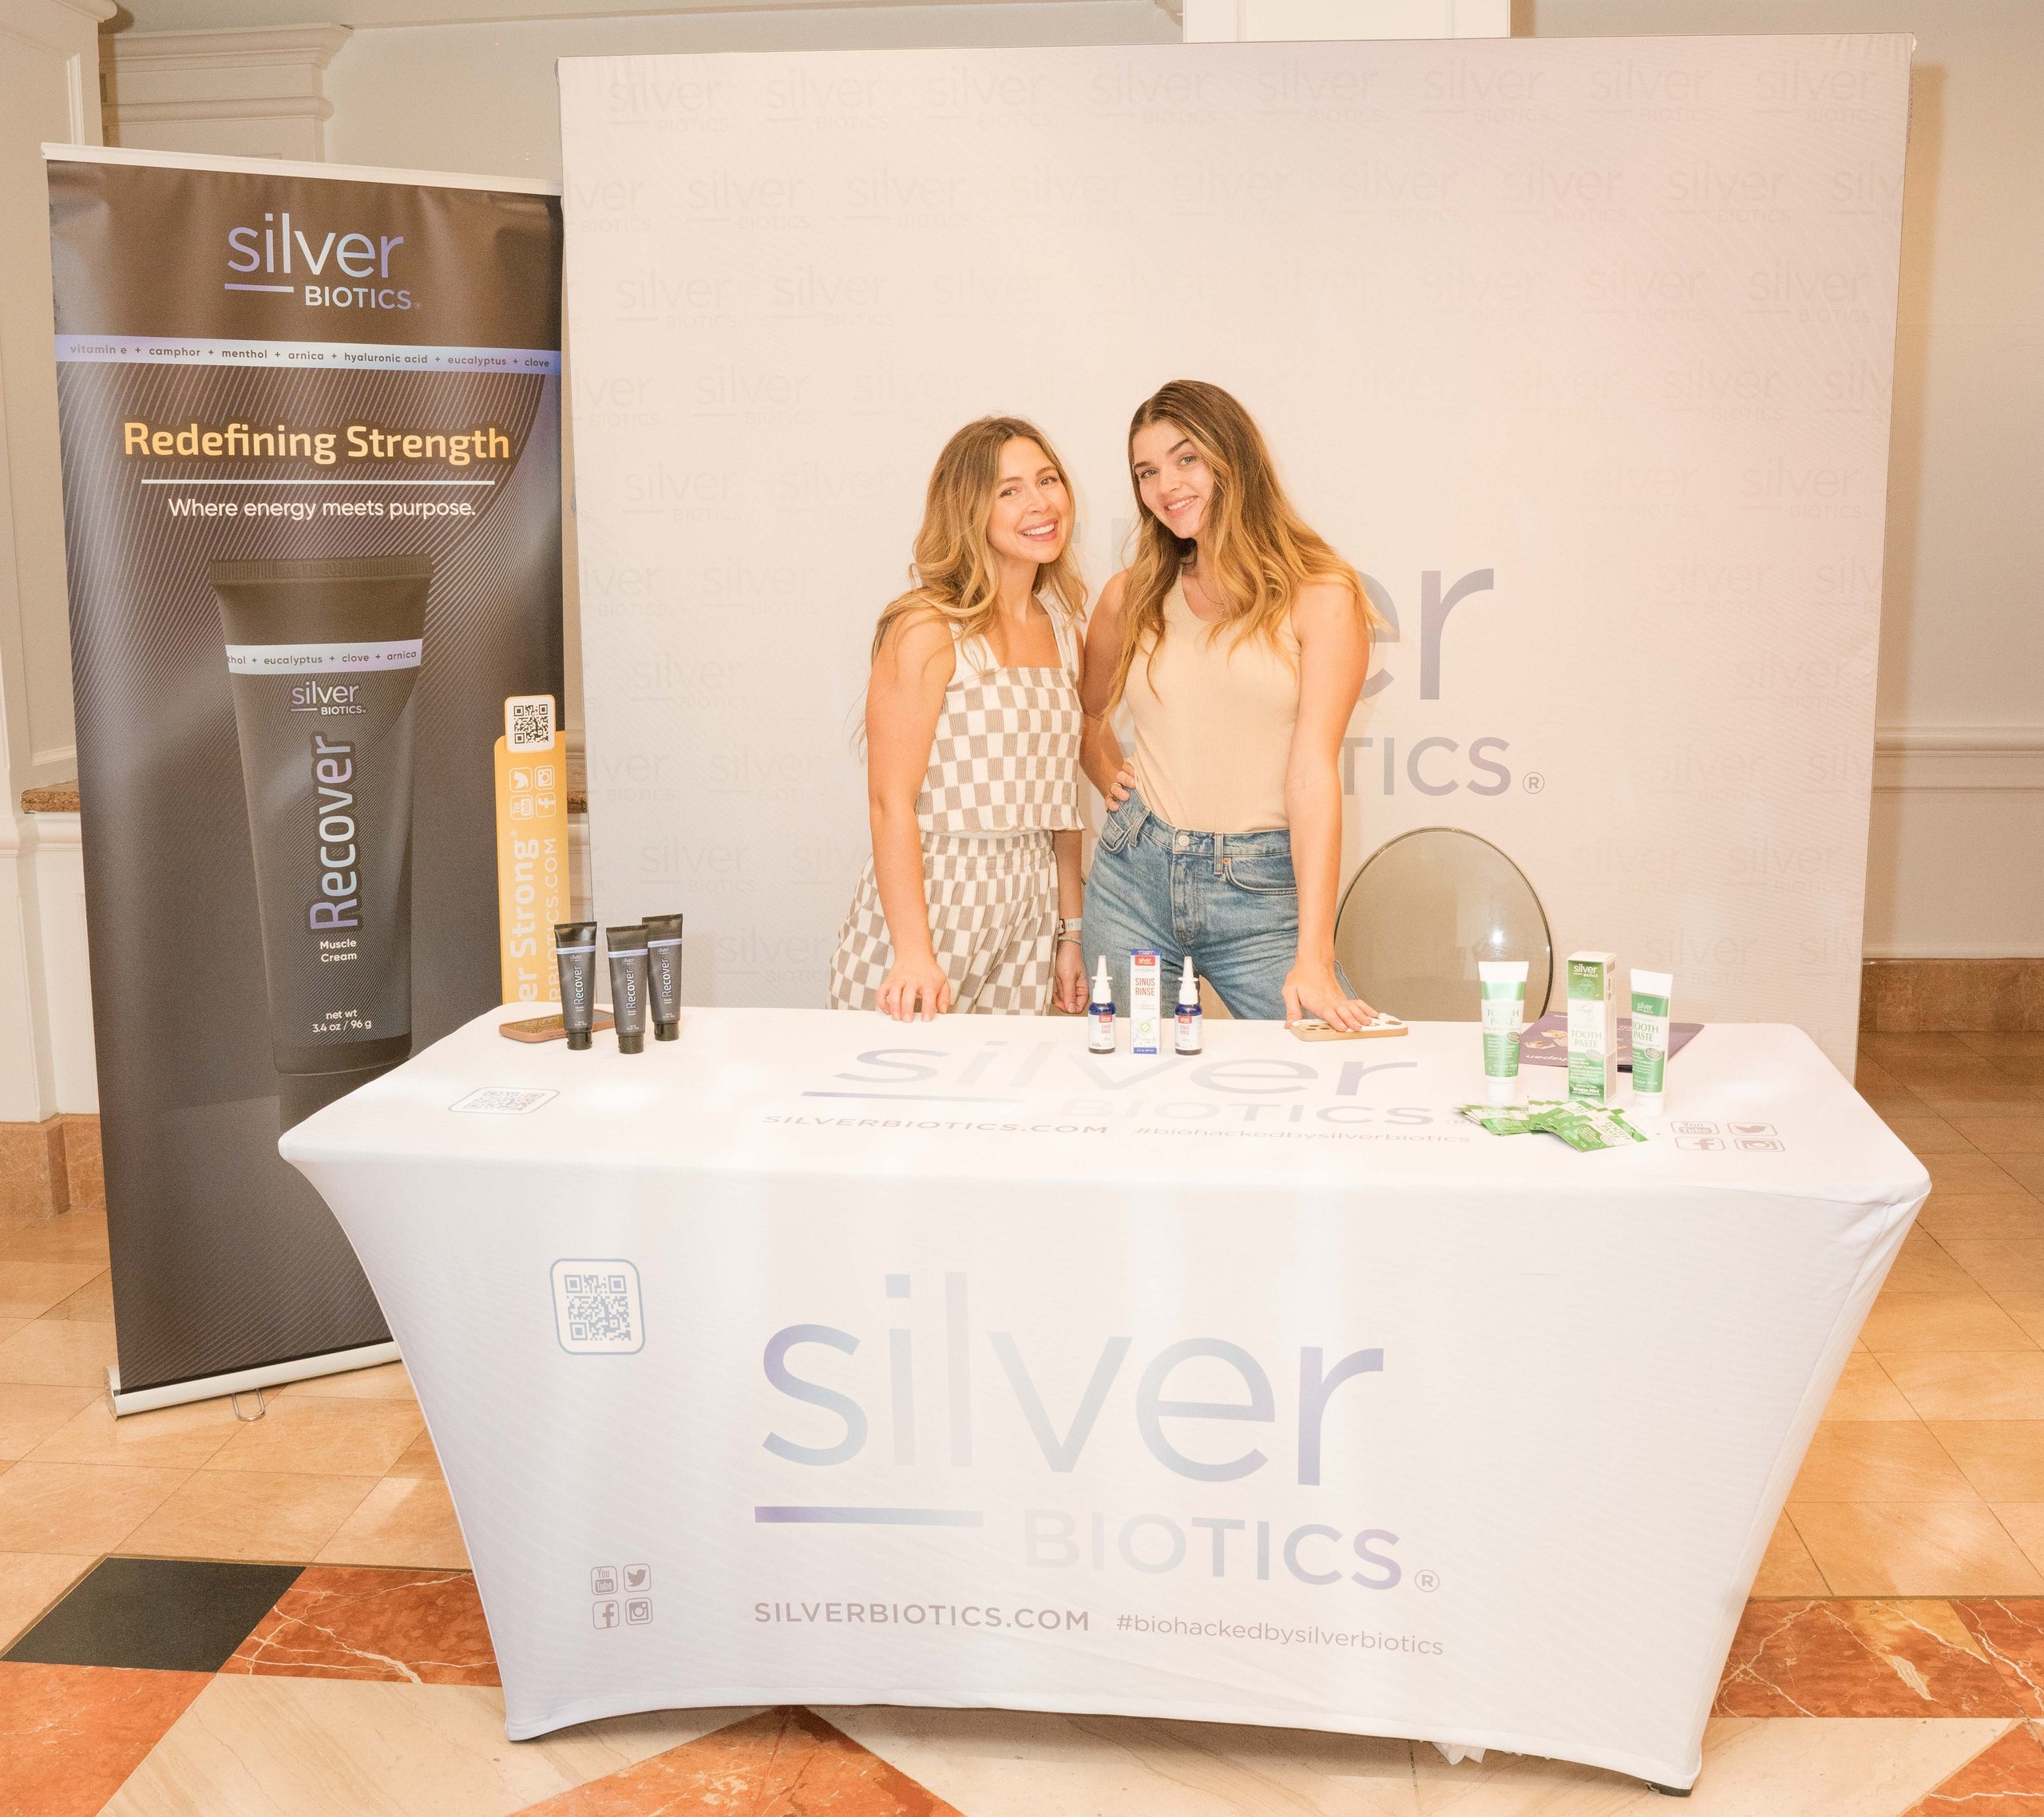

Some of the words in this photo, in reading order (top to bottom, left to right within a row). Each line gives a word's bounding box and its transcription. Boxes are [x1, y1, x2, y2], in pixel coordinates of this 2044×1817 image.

[608, 70, 722, 113] silver
[766, 69, 880, 109] silver
[927, 66, 1047, 106] silver
[1091, 61, 1214, 105] silver
[1256, 59, 1379, 102] silver
[1424, 59, 1546, 101] silver
[1590, 58, 1713, 101] silver
[1756, 58, 1877, 101] silver
[687, 168, 804, 210] silver
[847, 166, 966, 208] silver
[1503, 160, 1623, 203] silver
[1668, 160, 1788, 202] silver
[1832, 160, 1903, 203] silv
[228, 212, 404, 279] silver
[616, 268, 731, 310] silver
[773, 265, 891, 307] silver
[1585, 259, 1706, 301] silver
[1749, 259, 1868, 302] silver
[70, 344, 117, 355] vitamin
[149, 346, 200, 358] camphor
[221, 348, 267, 359] menthol
[288, 350, 324, 361] arnica
[344, 352, 401, 363] hyaluronic
[404, 354, 428, 364] acid
[447, 356, 507, 367] eucalyptus
[525, 358, 550, 368] clove
[696, 364, 810, 406] silver
[1662, 358, 1780, 400] silver
[1823, 360, 1892, 401] silv
[124, 422, 337, 467] Redefining
[347, 424, 510, 466] Strength
[625, 461, 738, 501] silver
[1740, 456, 1860, 498] silver
[168, 498, 239, 517] Where
[244, 503, 317, 521] energy
[322, 501, 384, 517] meets
[390, 501, 477, 521] purpose.
[1814, 554, 1881, 596] silv
[228, 655, 246, 664] thol
[263, 655, 323, 666] eucalyptus
[342, 654, 370, 663] clove
[386, 650, 417, 660] arnica
[291, 681, 359, 705] silver
[1342, 735, 1546, 797] TICS®
[310, 734, 359, 931] Recover
[640, 835, 751, 874] silver
[1729, 835, 1844, 875] silver
[544, 838, 561, 1001] RBIOTICS.COM
[319, 938, 357, 949] Muscle
[321, 952, 357, 962] Cream
[719, 926, 829, 964] silver
[1645, 927, 1759, 966] silver
[518, 967, 538, 1002] er
[573, 965, 584, 1006] Recover
[625, 968, 636, 1009] Recover
[661, 958, 672, 998] Recover
[1135, 977, 1155, 987] SINUS
[1573, 964, 1598, 974] silver
[1135, 987, 1155, 996] RINSE
[312, 1023, 327, 1032] 3.4
[351, 1019, 362, 1028] 96
[365, 1020, 372, 1029] g
[326, 1011, 343, 1019] net
[345, 1008, 358, 1017] wt
[1632, 1021, 1659, 1034] TOOTH
[1571, 1030, 1602, 1039] TOOTH
[1575, 1039, 1598, 1048] PASTE
[1634, 1031, 1654, 1041] PASTE
[830, 1040, 1419, 1097] silver
[763, 1114, 1110, 1136] SILVERBIOTICS.COM
[1134, 1125, 1472, 1143] #biohackedbysilverbiotics
[761, 1271, 1385, 1486] silver
[596, 1568, 610, 1578] You
[753, 1601, 1091, 1633] SILVERBIOTICS.COM
[1116, 1611, 1445, 1658] #biohackedbysilverbiotics
